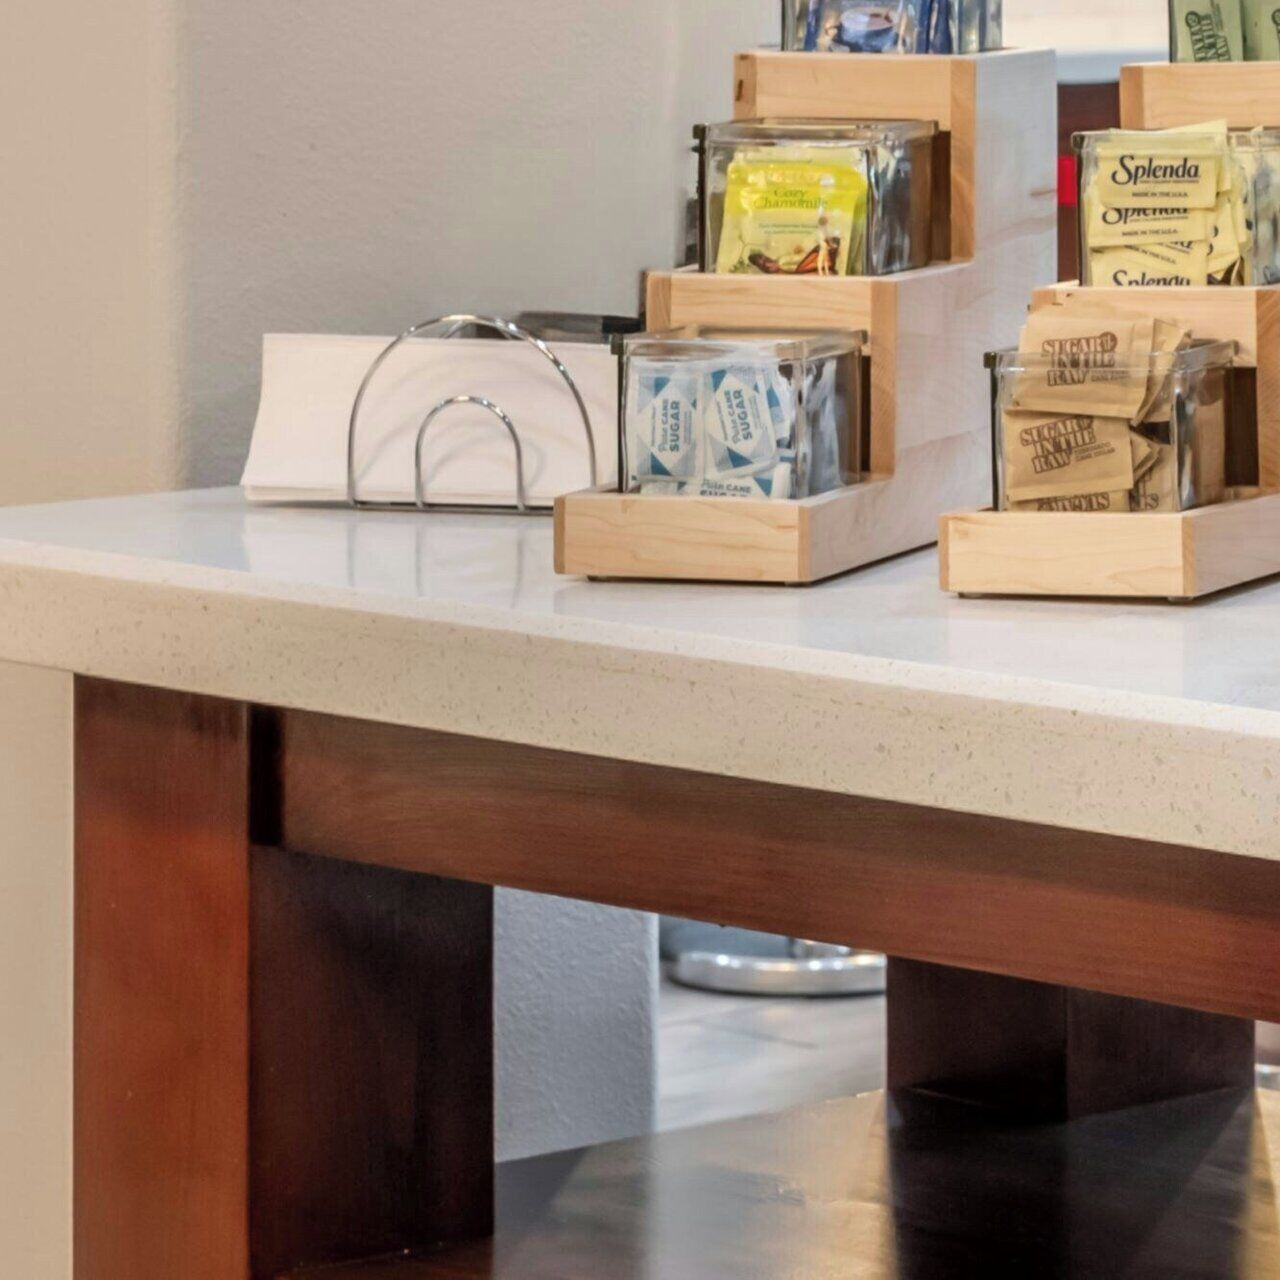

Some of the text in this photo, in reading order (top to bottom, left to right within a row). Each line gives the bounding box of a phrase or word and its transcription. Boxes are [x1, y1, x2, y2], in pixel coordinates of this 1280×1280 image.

[1111, 154, 1200, 186] Splenda
[1041, 335, 1102, 357] SUGAR
[1046, 369, 1089, 387] RAW
[661, 398, 669, 425] CANE
[724, 389, 736, 417] CANE
[732, 388, 753, 441] SUGAR
[669, 400, 680, 452] SUGAR
[1020, 416, 1081, 447] SUGAR
[1055, 427, 1097, 451] THE
[1031, 450, 1072, 474] RAW
[726, 483, 752, 494] CANE
